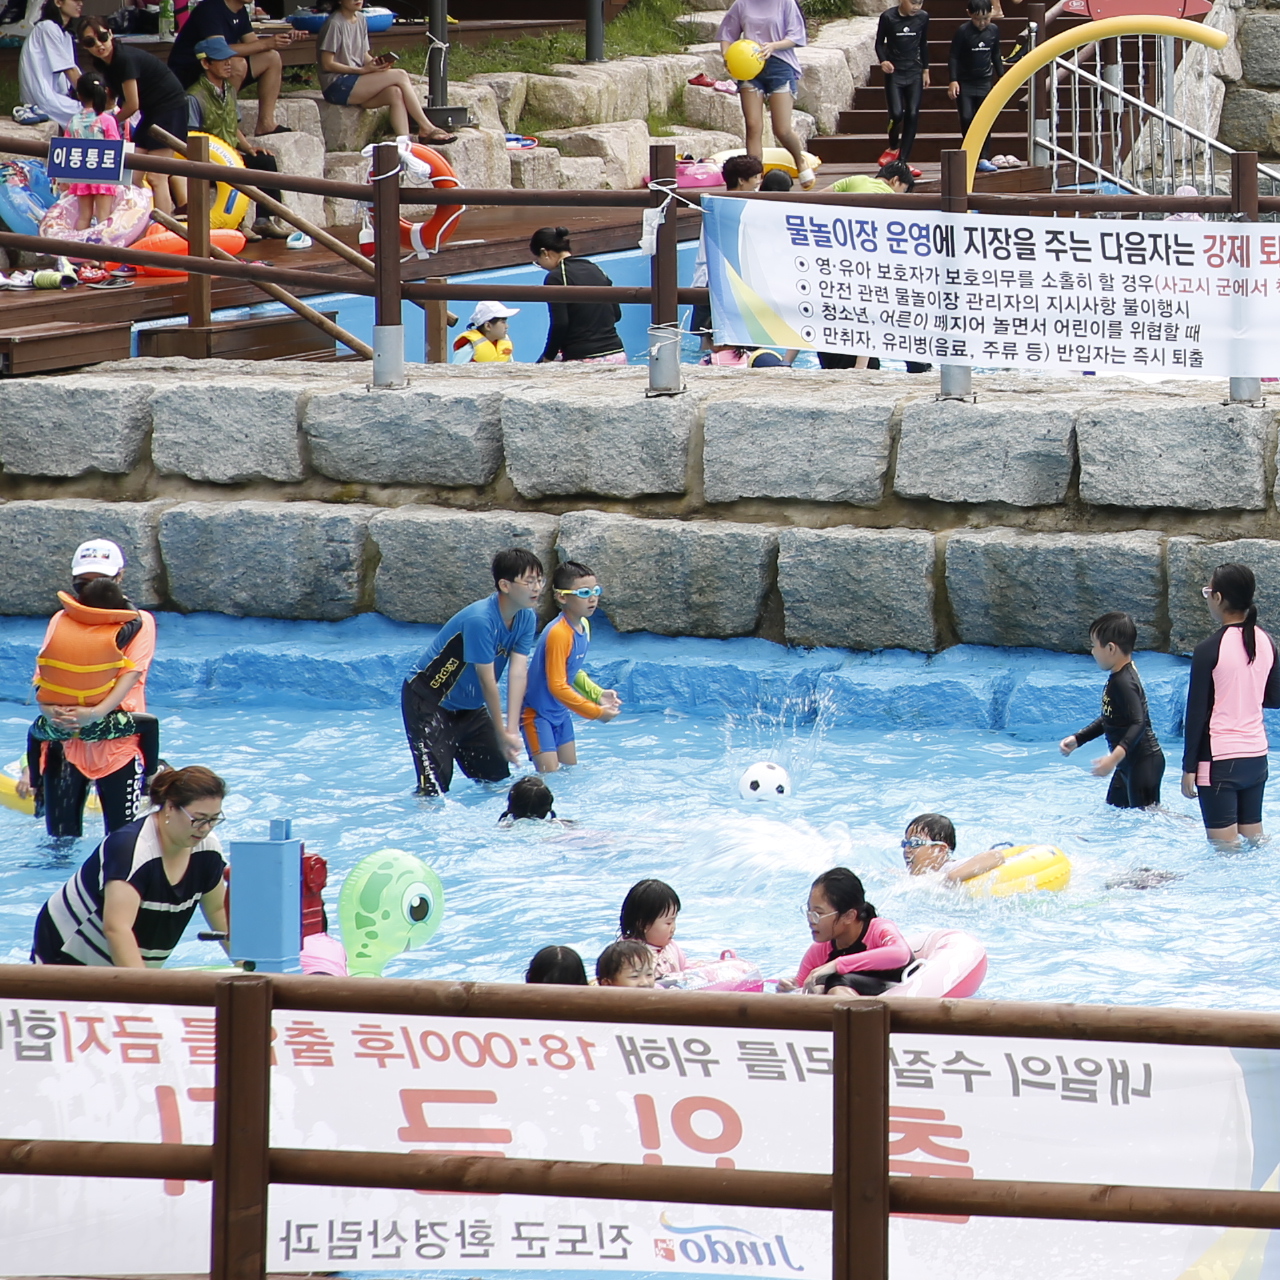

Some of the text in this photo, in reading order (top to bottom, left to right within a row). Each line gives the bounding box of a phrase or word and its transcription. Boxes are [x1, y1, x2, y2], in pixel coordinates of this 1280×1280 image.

[53, 147, 115, 169] 이동통로
[785, 214, 878, 253] 물놀이장
[886, 221, 956, 259] 운영에
[964, 226, 1037, 261] 지장을
[1044, 229, 1093, 263] 주는
[1099, 231, 1195, 267] 다음자는
[1202, 234, 1251, 269] 강제
[815, 257, 872, 281] 영·유아
[877, 262, 940, 287] 보호자가
[945, 267, 1035, 291] 보호의무를
[1041, 270, 1093, 292] 소홀히
[1098, 272, 1115, 293] 할
[1215, 276, 1268, 298] 군에서
[818, 280, 1191, 319] 안전 관련 물놀이장 관리자의 지시사항 불이행시
[821, 303, 876, 327] 청소년,
[880, 309, 928, 331] 어른이
[992, 316, 1047, 336] 놀면서
[1053, 318, 1123, 340] 어린이를
[1130, 321, 1180, 342] 위협할
[1185, 324, 1201, 343] 때
[823, 326, 1204, 369] 만취자, 유리병(음료, 주류 등) 반입자는 즉시 퇴출
[125, 780, 133, 821] EXPEDI
